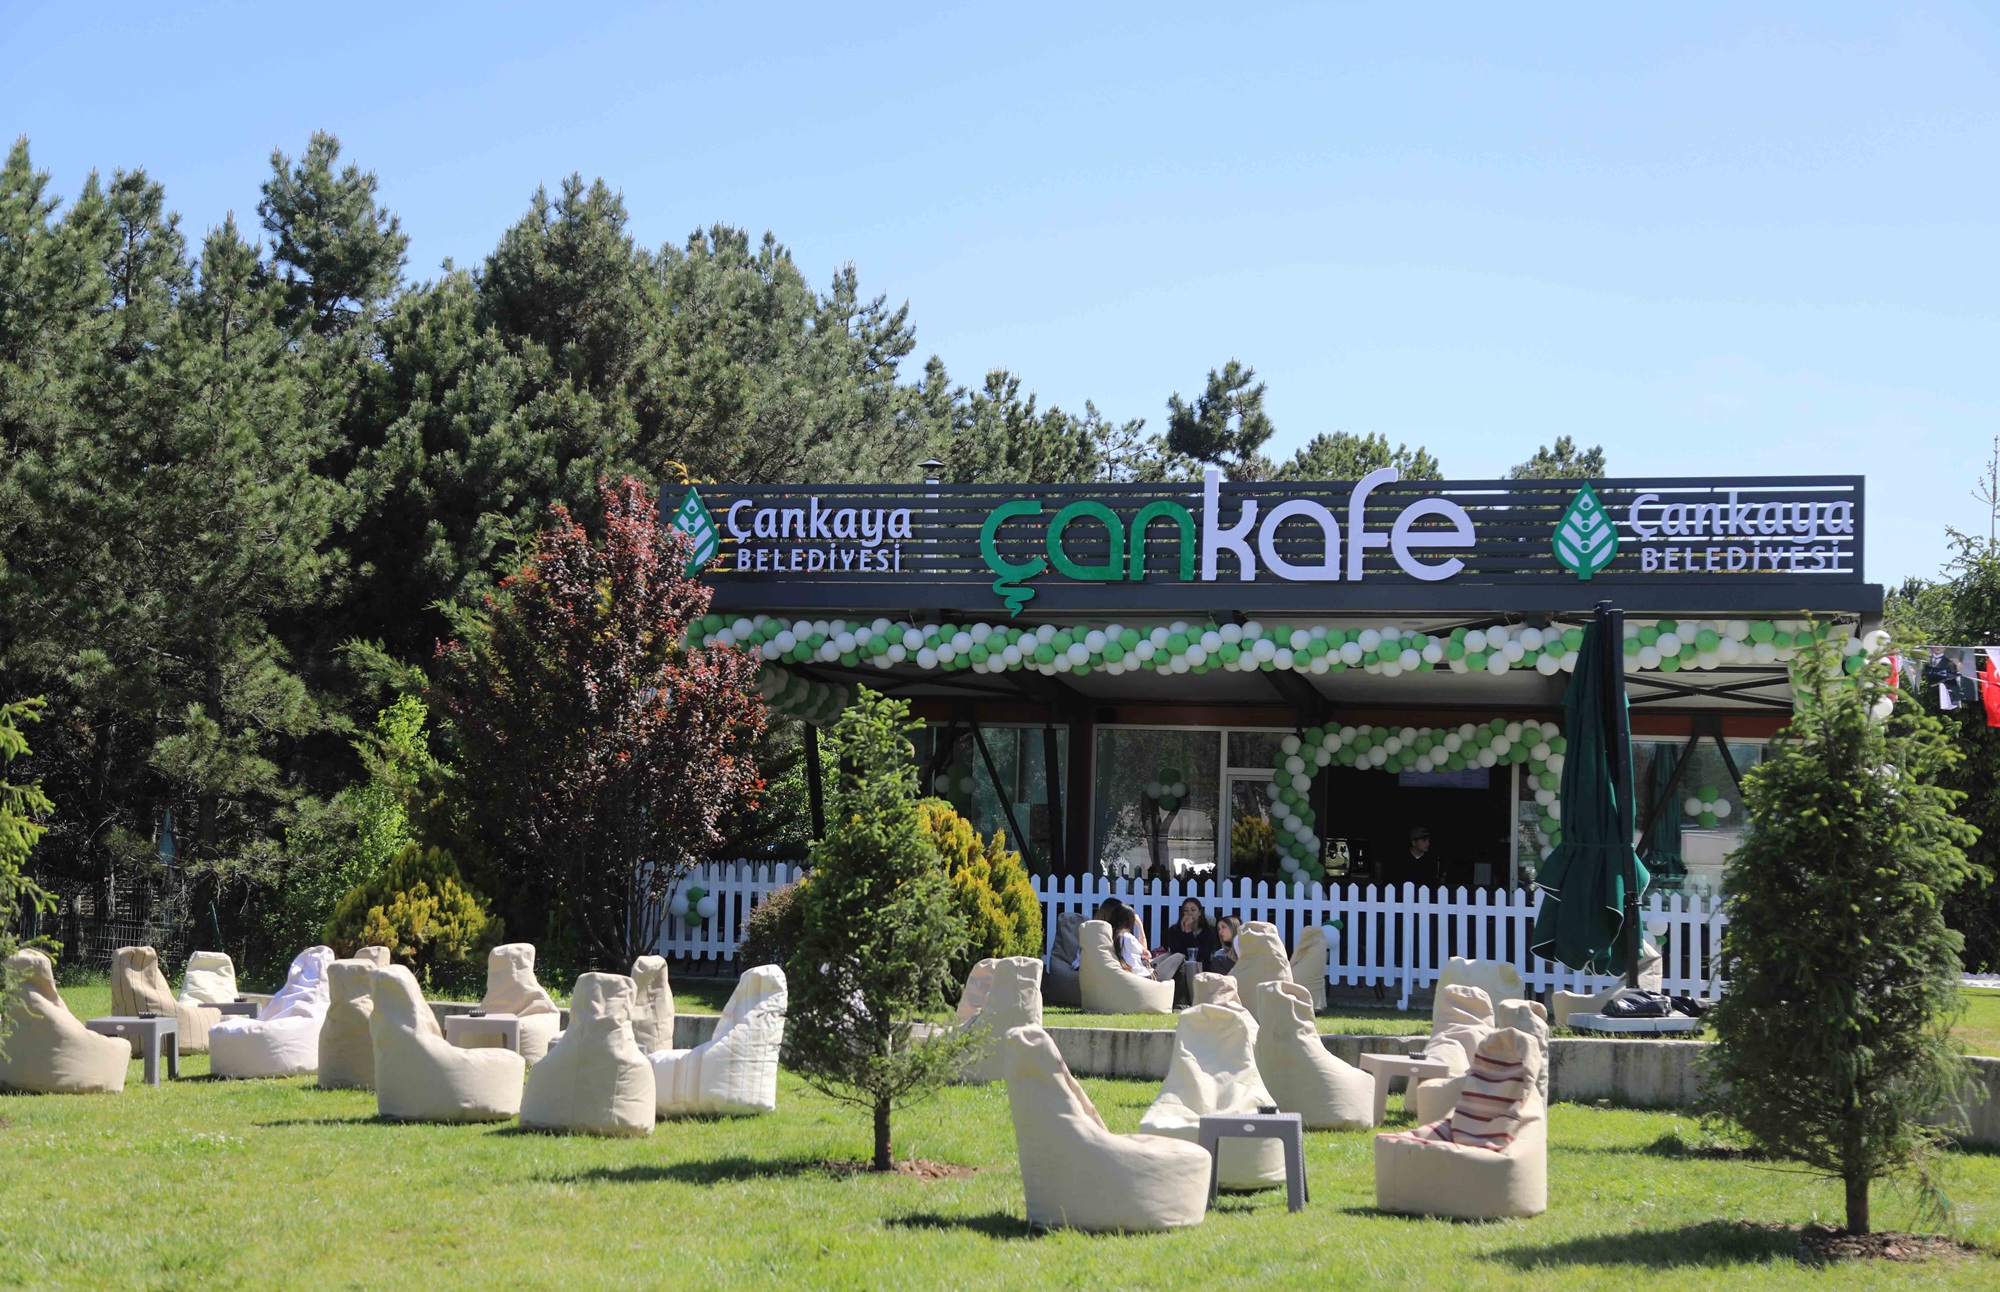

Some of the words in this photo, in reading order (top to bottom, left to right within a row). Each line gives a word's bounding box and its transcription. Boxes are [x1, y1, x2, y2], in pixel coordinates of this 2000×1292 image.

[728, 497, 912, 547] Çankaya
[979, 467, 1476, 617] çankafe
[1628, 491, 1854, 544] Çankaya
[736, 543, 901, 572] BELEDİYESİ
[1641, 540, 1839, 572] BELEDİYESİ
